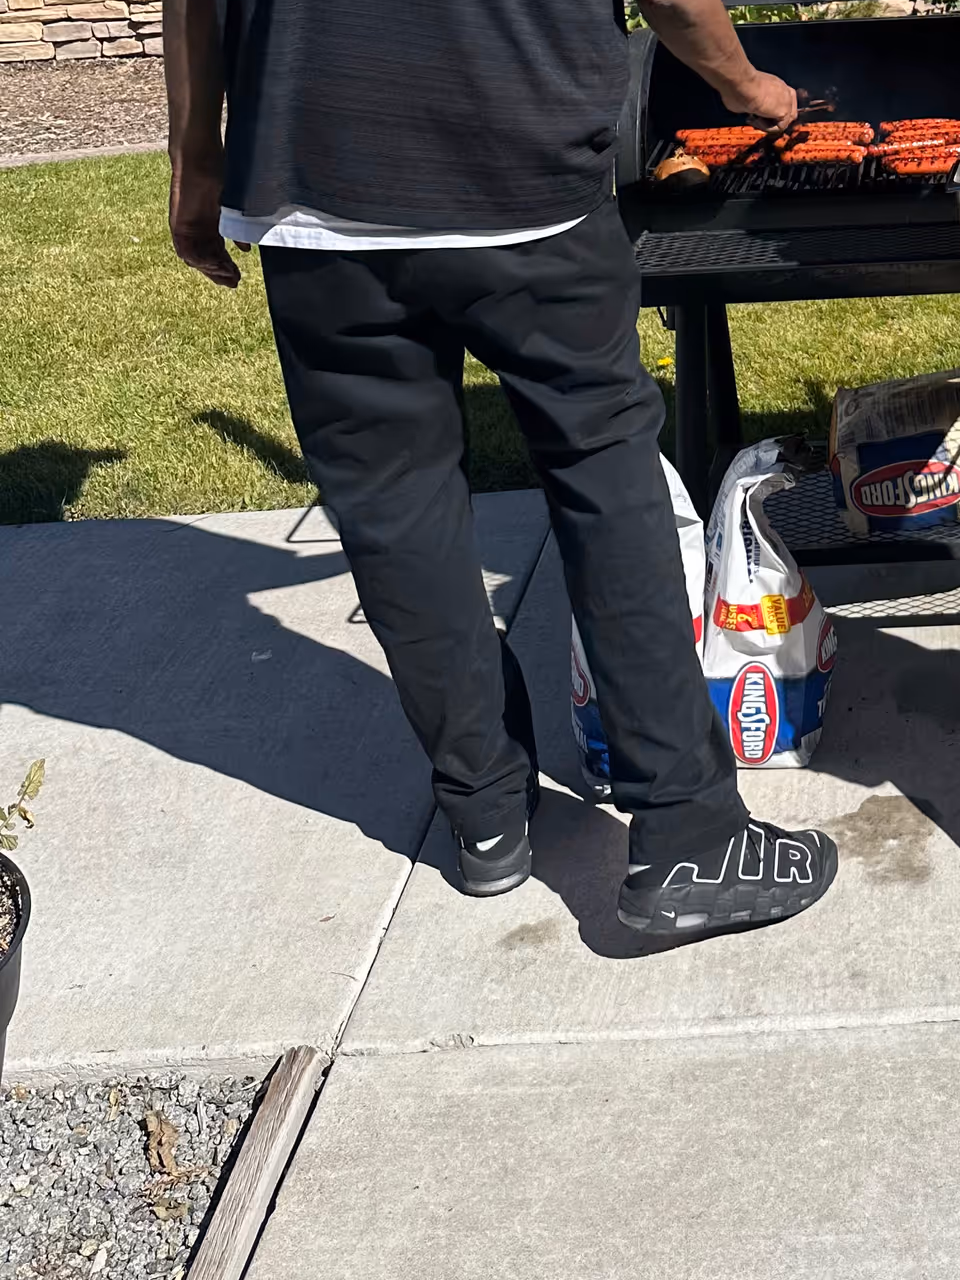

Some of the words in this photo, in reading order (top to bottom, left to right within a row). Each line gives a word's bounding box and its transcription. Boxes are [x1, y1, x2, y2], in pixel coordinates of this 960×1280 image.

[860, 470, 960, 509] KINGSFORD
[726, 605, 738, 631] USES
[736, 613, 752, 625] 6
[771, 597, 787, 633] VALUE
[736, 672, 771, 759] KINGSFORD
